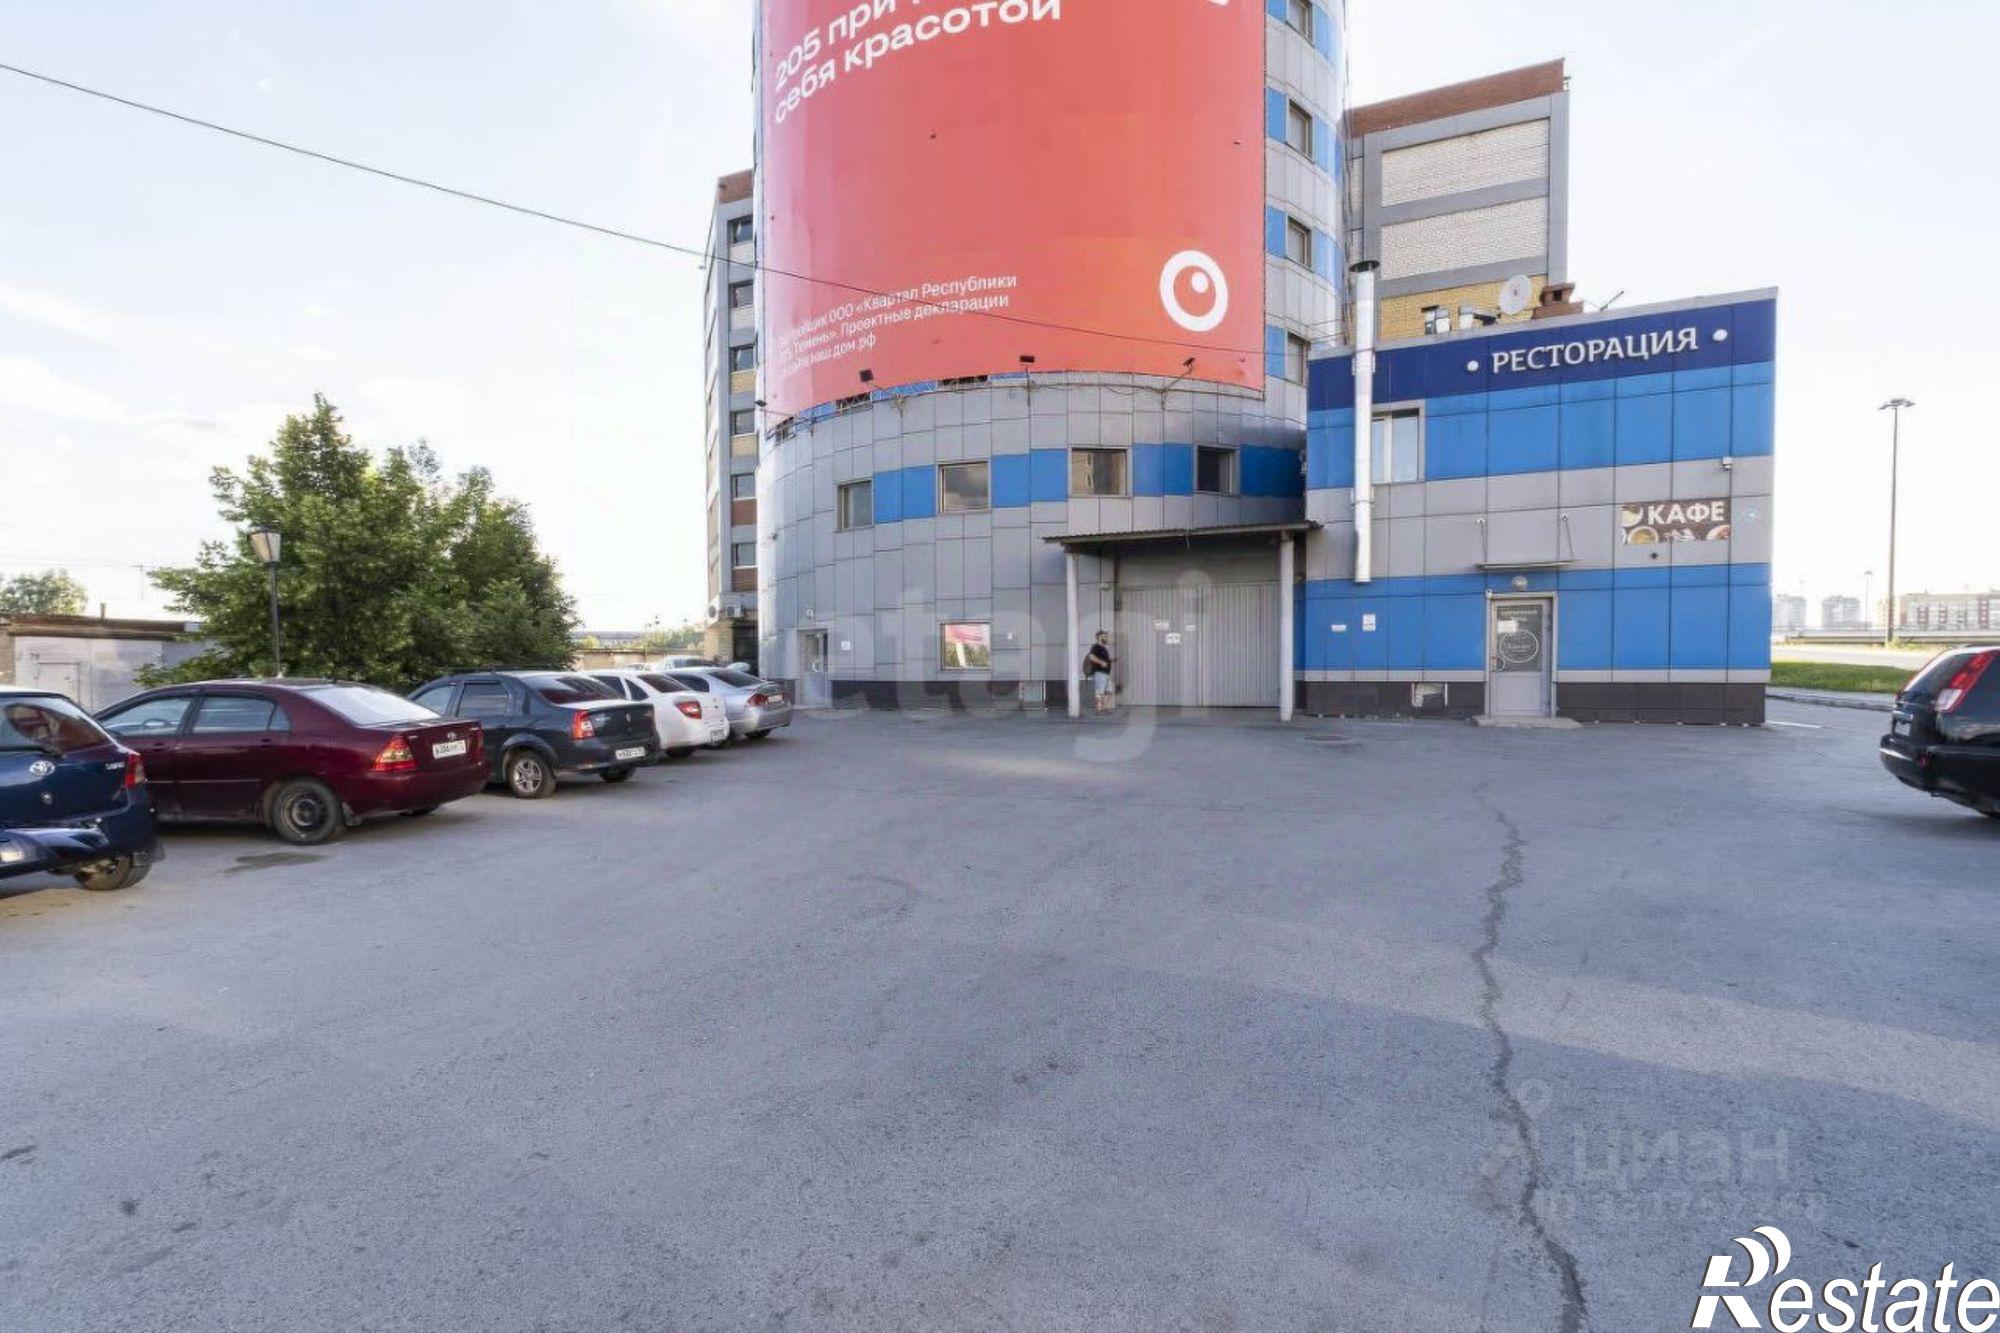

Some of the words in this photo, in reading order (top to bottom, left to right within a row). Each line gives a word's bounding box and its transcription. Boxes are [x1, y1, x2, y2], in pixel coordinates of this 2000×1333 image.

[775, 27, 822, 92] 205
[775, 58, 837, 124] себя
[922, 275, 1017, 298] Республики
[1492, 327, 1698, 374] РЕСТОРАЦИЯ
[1648, 501, 1724, 525] КАФЕ
